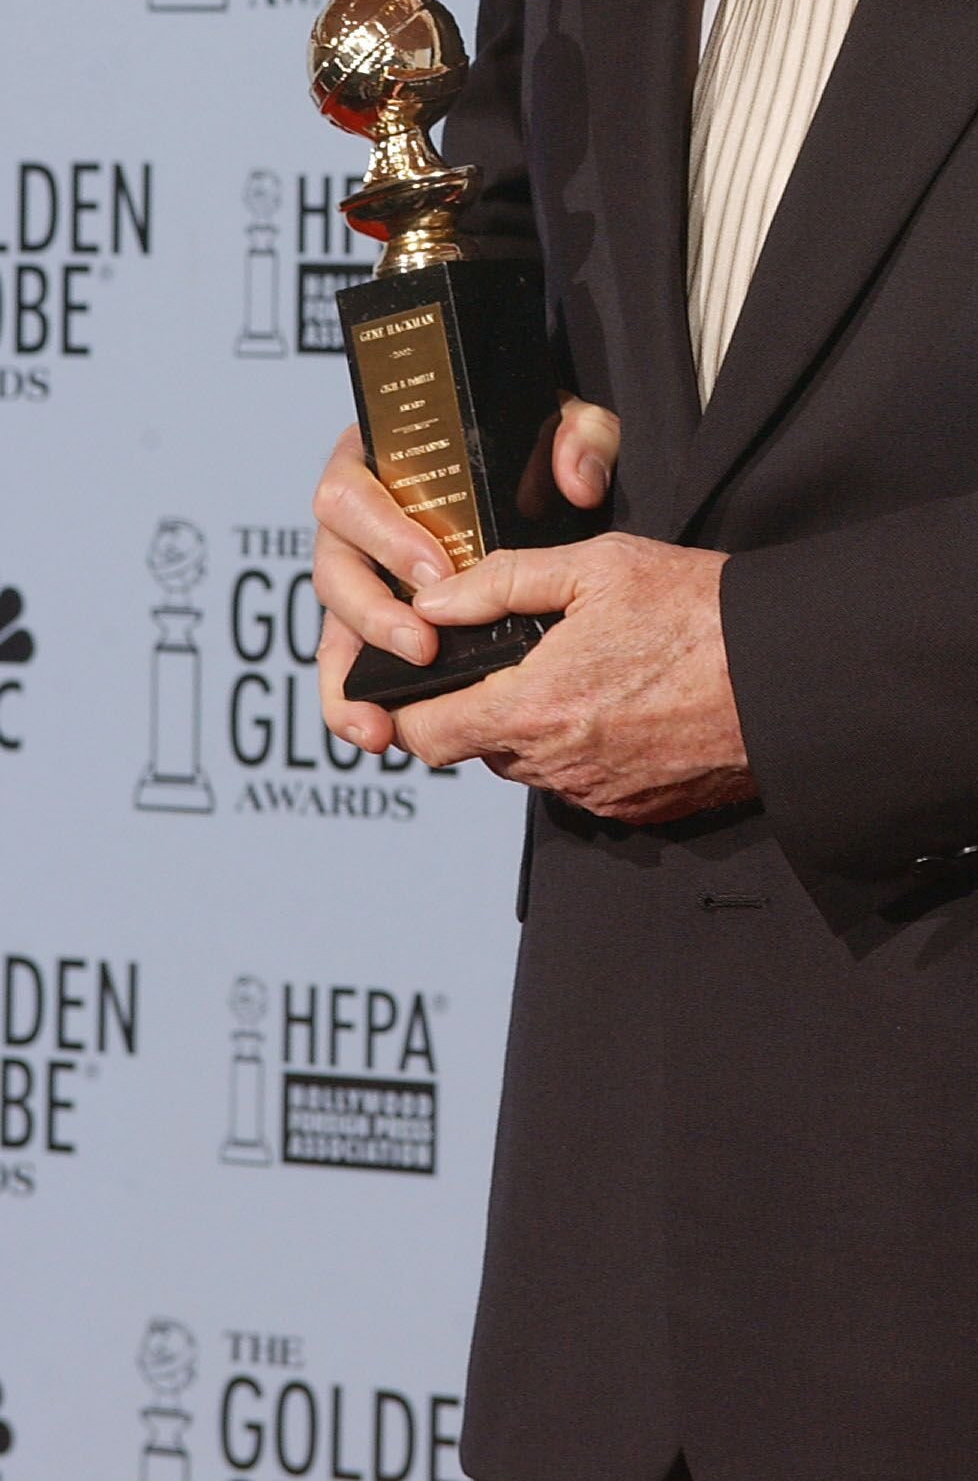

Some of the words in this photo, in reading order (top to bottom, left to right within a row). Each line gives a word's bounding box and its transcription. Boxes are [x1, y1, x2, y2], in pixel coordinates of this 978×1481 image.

[359, 325, 386, 343] GENE
[387, 313, 436, 336] HACKMAN
[236, 778, 417, 821] AWARDS
[283, 982, 437, 1074] HFPA
[224, 1329, 304, 1369] THE
